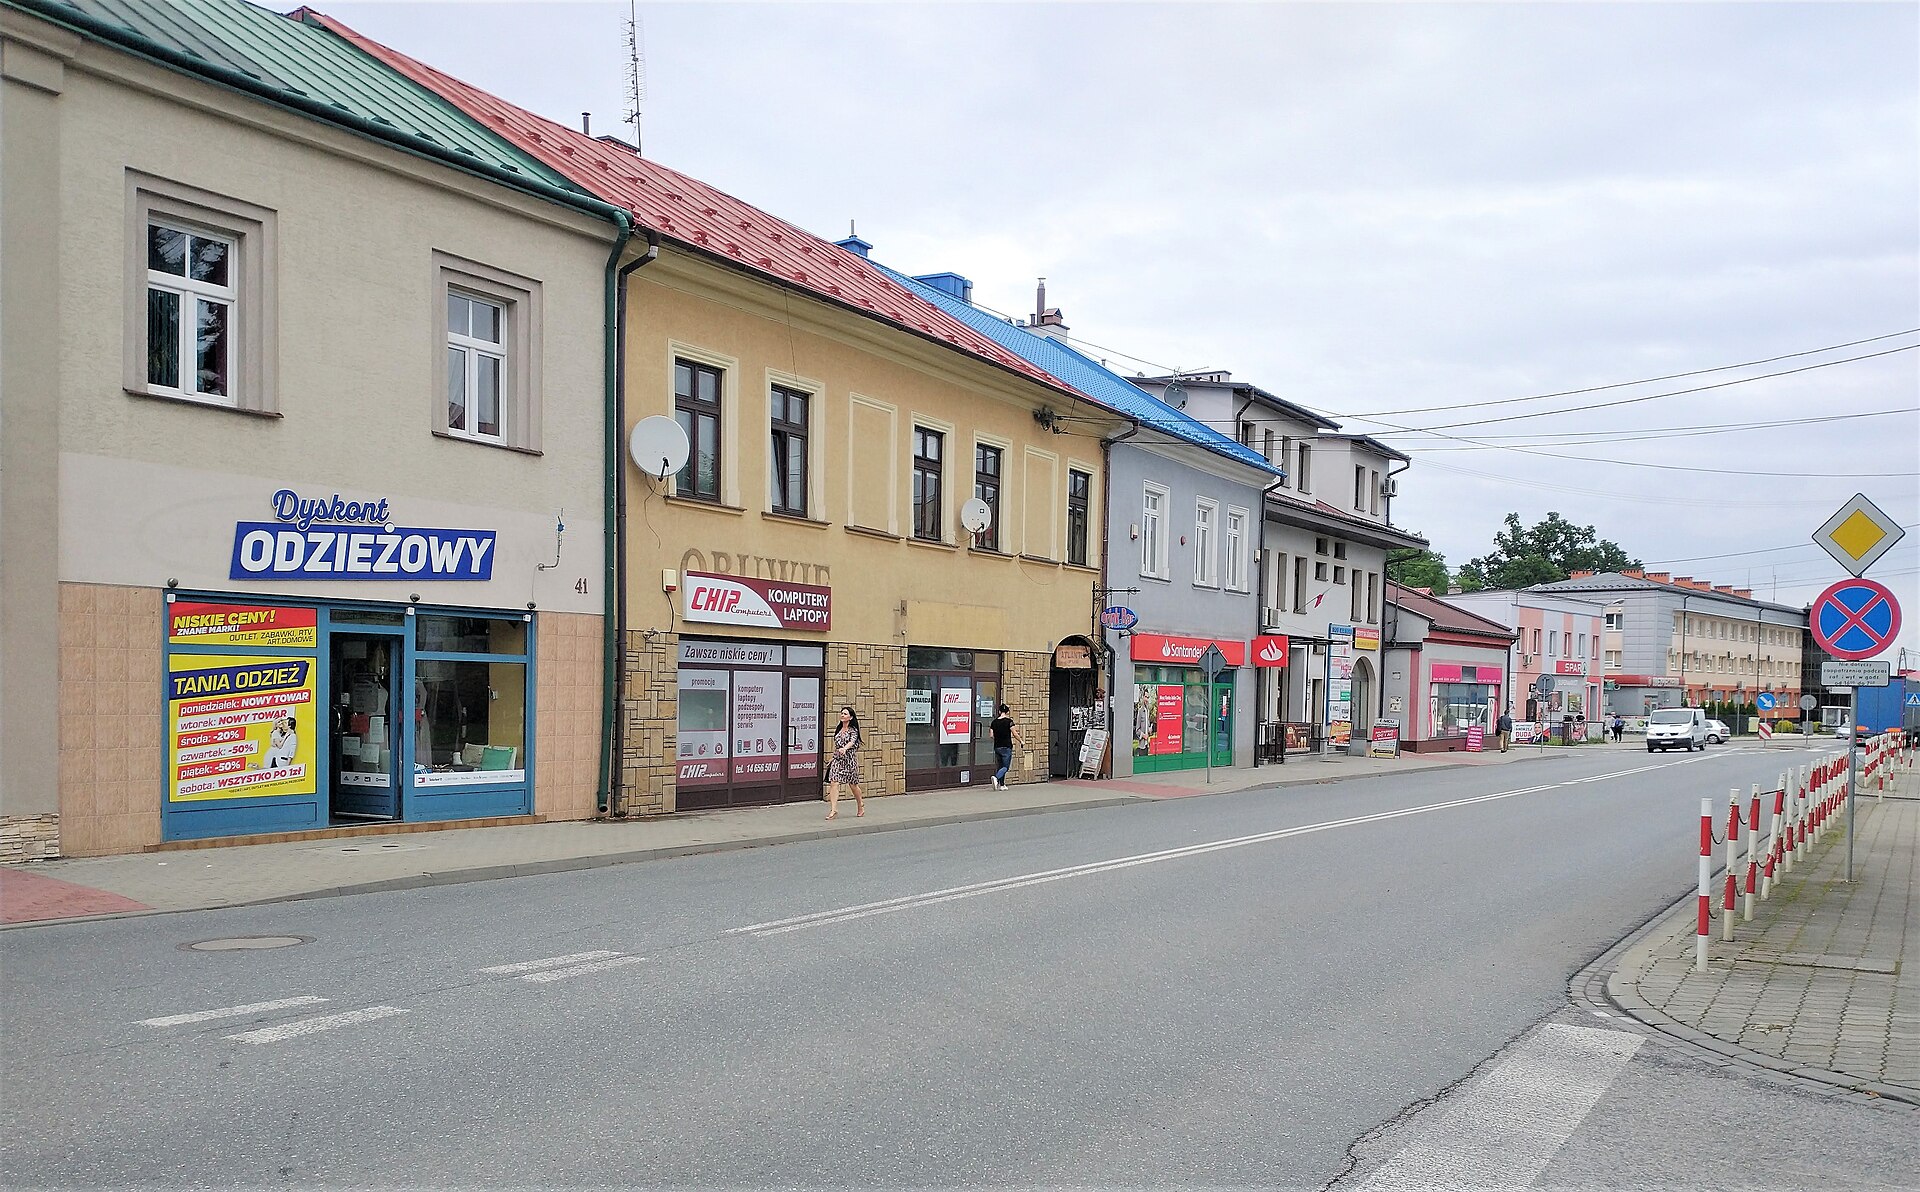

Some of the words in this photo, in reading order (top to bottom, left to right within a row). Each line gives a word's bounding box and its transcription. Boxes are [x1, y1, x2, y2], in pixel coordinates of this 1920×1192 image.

[272, 489, 390, 530] Dyskont
[240, 522, 492, 574] ODZIEŻOWY
[575, 577, 588, 594] 41
[691, 586, 742, 612] CHIP
[768, 588, 829, 608] KOMPUTERY
[731, 605, 772, 617] Computers
[784, 607, 829, 624] LAPTOPY
[173, 613, 225, 629] NISKIE
[177, 626, 208, 636] ZNANE
[209, 624, 240, 634] MARKI!
[685, 645, 717, 659] Zawsze
[720, 647, 746, 661] niskie
[747, 650, 768, 663] ceny
[1171, 643, 1203, 658] Santander
[1564, 662, 1582, 673] SPAR
[173, 673, 231, 695] TANIA
[235, 663, 300, 689] ODZIEŻ
[691, 678, 716, 686] promocje
[737, 685, 764, 694] komputery
[737, 693, 757, 703] laptopy
[180, 699, 240, 717] poniedziałek:
[241, 695, 273, 708] NOWY
[273, 691, 309, 703] TOWAR
[737, 703, 765, 712] podzespoły
[180, 718, 217, 731] wtorek:
[218, 712, 251, 726] NOWY
[252, 709, 288, 721] TOWAR
[737, 711, 778, 721] oprogramowanie
[737, 721, 754, 729] serwis
[180, 734, 211, 746] środa:
[213, 729, 240, 741] -20%
[180, 748, 226, 762] czwartek:
[228, 743, 254, 754] -50%
[180, 765, 213, 780] piątek:
[214, 760, 241, 771] -50%
[680, 764, 708, 779] CHIP
[746, 764, 753, 773] 14
[180, 781, 215, 794] sobota:
[217, 771, 272, 788] WSZYSTKO
[273, 769, 287, 779] PO
[289, 766, 302, 776] 1zł
